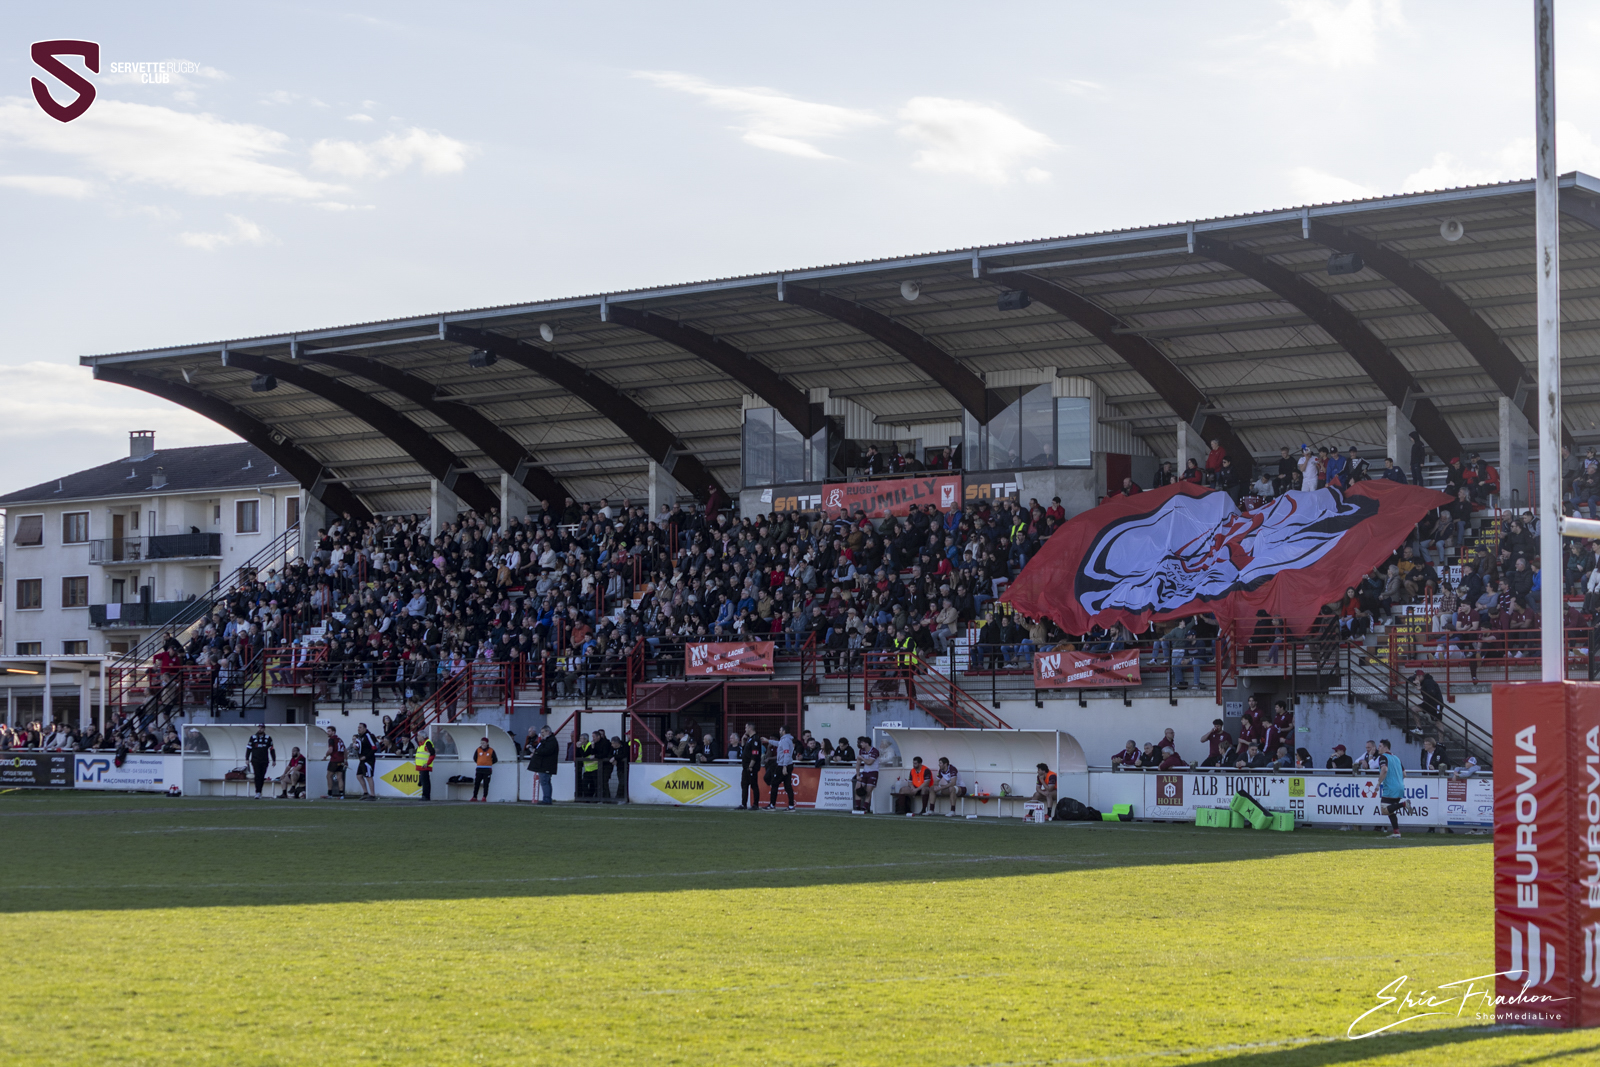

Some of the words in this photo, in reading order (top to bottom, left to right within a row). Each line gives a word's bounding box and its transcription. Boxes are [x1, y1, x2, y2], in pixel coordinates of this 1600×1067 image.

[846, 485, 879, 496] RUGBY
[849, 478, 937, 518] RUMILLY
[690, 644, 708, 661] XV
[1040, 653, 1061, 673] XV
[1067, 670, 1093, 682] ENSEMBLE
[1113, 657, 1137, 671] VICTOIRE
[75, 758, 111, 783] MP
[392, 773, 421, 783] AXIMU
[664, 780, 704, 790] AXIMUM
[1162, 775, 1178, 783] ALB
[1192, 776, 1218, 796] ALB
[1225, 776, 1270, 797] HOTEL
[1316, 782, 1360, 798] Crédit
[1157, 797, 1183, 805] HOTEL
[1146, 805, 1190, 817] Restaurant
[1317, 804, 1365, 816] RUMILLY
[1373, 805, 1429, 817] AANAIS
[1514, 724, 1539, 909] EUROVIA
